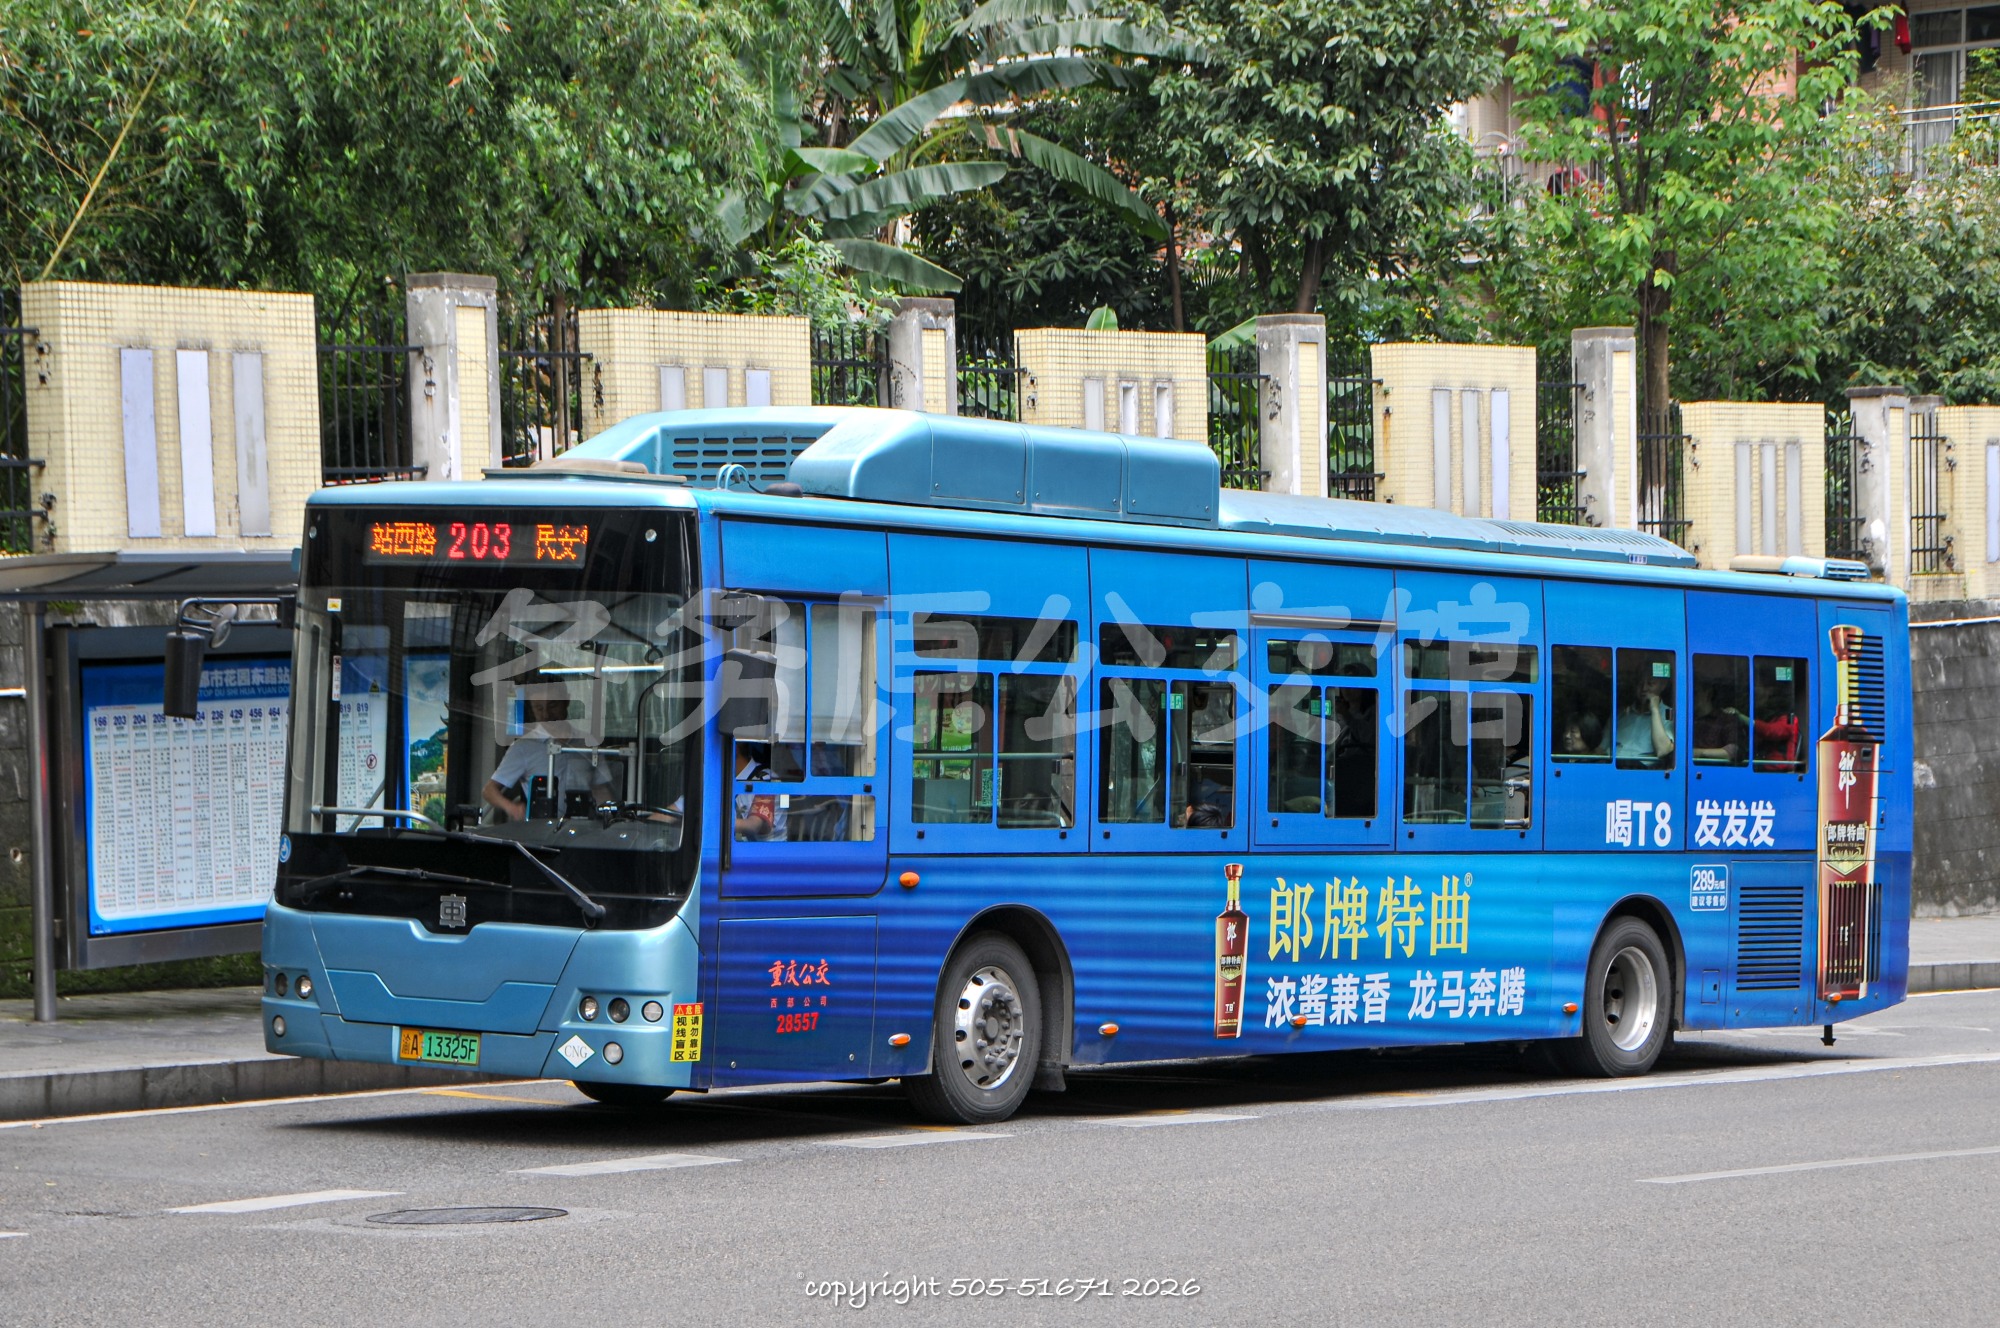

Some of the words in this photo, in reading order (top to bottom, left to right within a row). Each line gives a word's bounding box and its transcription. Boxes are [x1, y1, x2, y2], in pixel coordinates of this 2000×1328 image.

[371, 522, 437, 555] 站西路
[449, 523, 511, 559] 203
[113, 714, 127, 726] 203
[133, 713, 147, 725] 204
[229, 708, 243, 719] 429
[249, 707, 263, 718] 456
[268, 706, 280, 716] 464
[356, 702, 369, 712] 819
[1605, 800, 1672, 848] 喝T8
[1694, 799, 1776, 848] 发发发
[1828, 823, 1866, 842] 郎牌特曲
[1267, 874, 1471, 963] 郎牌特曲
[768, 958, 831, 988] 重庆公交
[685, 1004, 702, 1015] 危险
[770, 995, 828, 1009] 西部公司
[1265, 971, 1391, 1029] 浓酱兼香
[1407, 966, 1526, 1022] 龙马奔腾
[776, 1011, 820, 1034] 28557
[674, 1016, 687, 1061] 视线盲区
[688, 1015, 700, 1060] 请勿靠近
[563, 1044, 589, 1059] CNG
